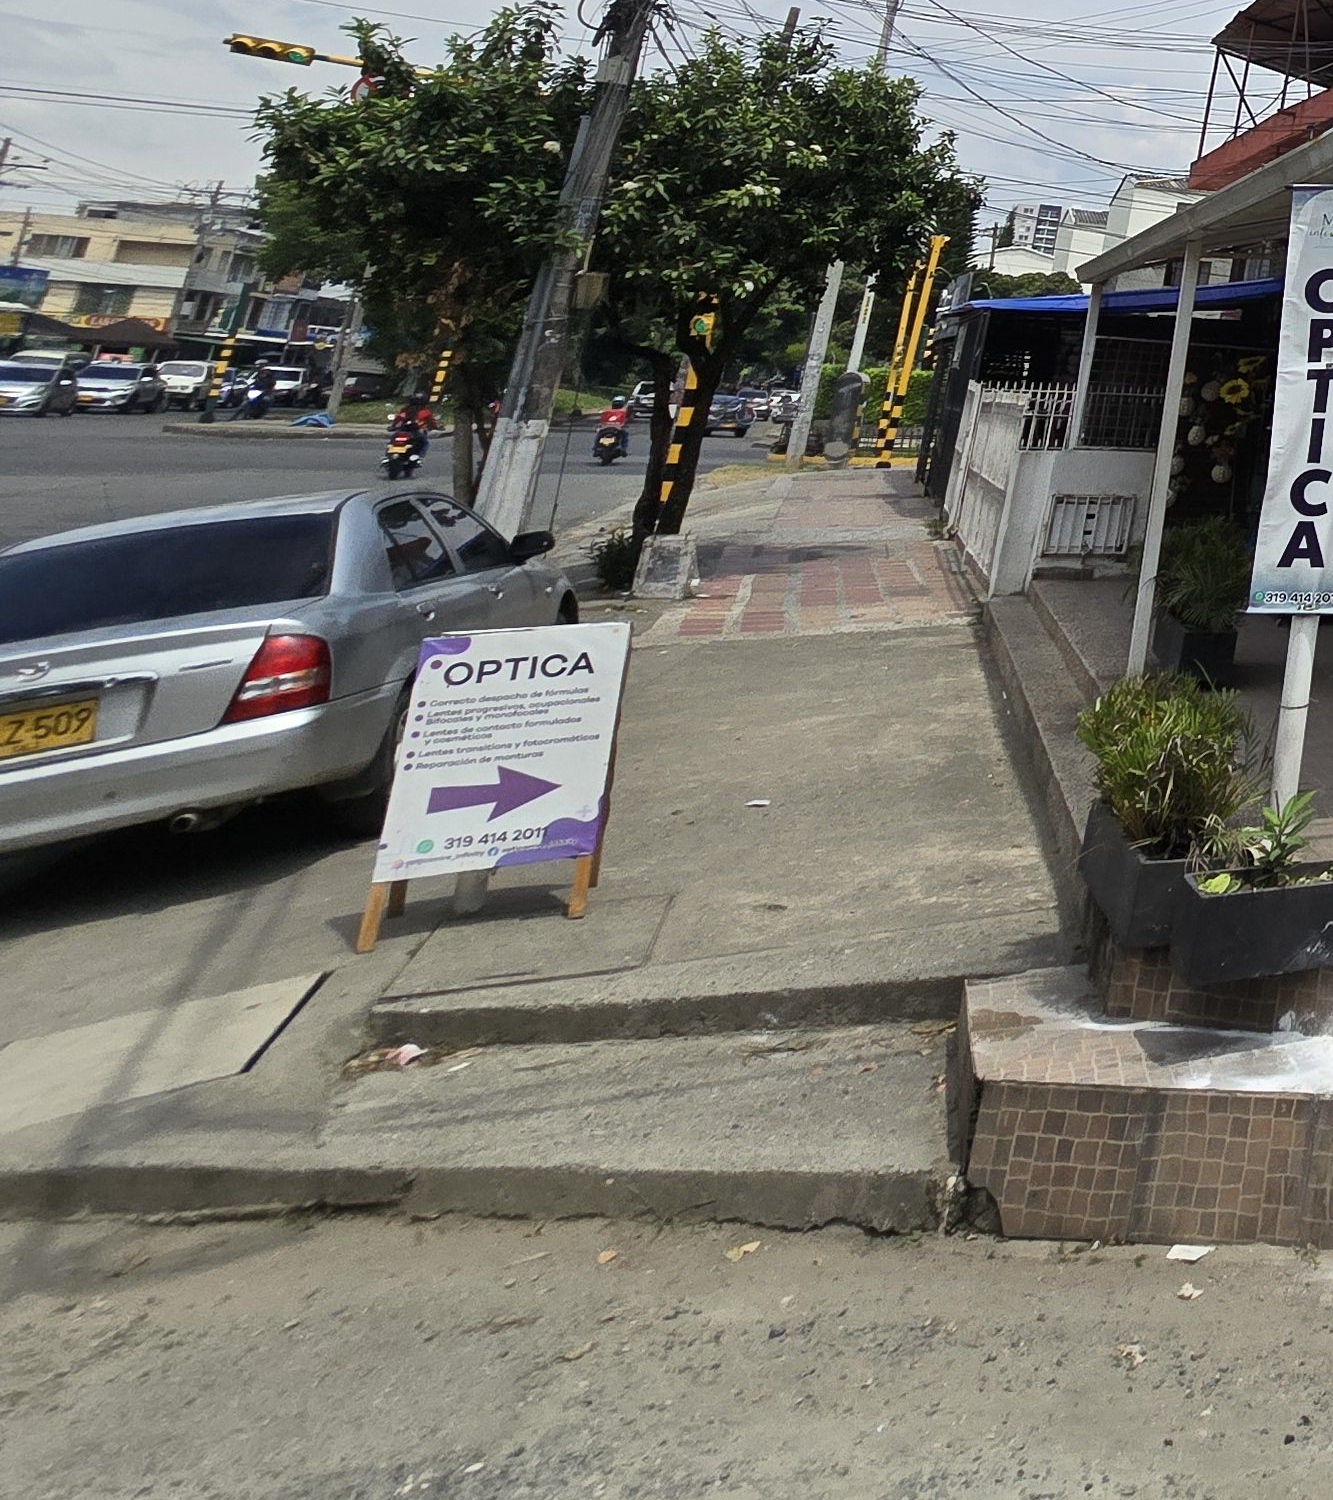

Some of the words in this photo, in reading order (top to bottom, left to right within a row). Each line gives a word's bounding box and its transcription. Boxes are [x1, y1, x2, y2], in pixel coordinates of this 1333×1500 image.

[1265, 592, 1287, 603] 319
[1289, 592, 1312, 603] 414
[443, 652, 594, 688] OPTICA
[430, 696, 476, 707] Correcto
[478, 692, 528, 704] despacho
[530, 690, 543, 698] de
[427, 707, 462, 718] Lentes
[423, 727, 458, 738] Lentes
[460, 726, 474, 735] de
[476, 723, 522, 733] contacto
[524, 716, 582, 728] formulados
[418, 748, 454, 758] Lentes
[479, 755, 492, 764] de
[493, 750, 545, 762] monturas
[444, 835, 474, 850] 319
[477, 831, 508, 846] 414
[511, 826, 548, 841] 2011
